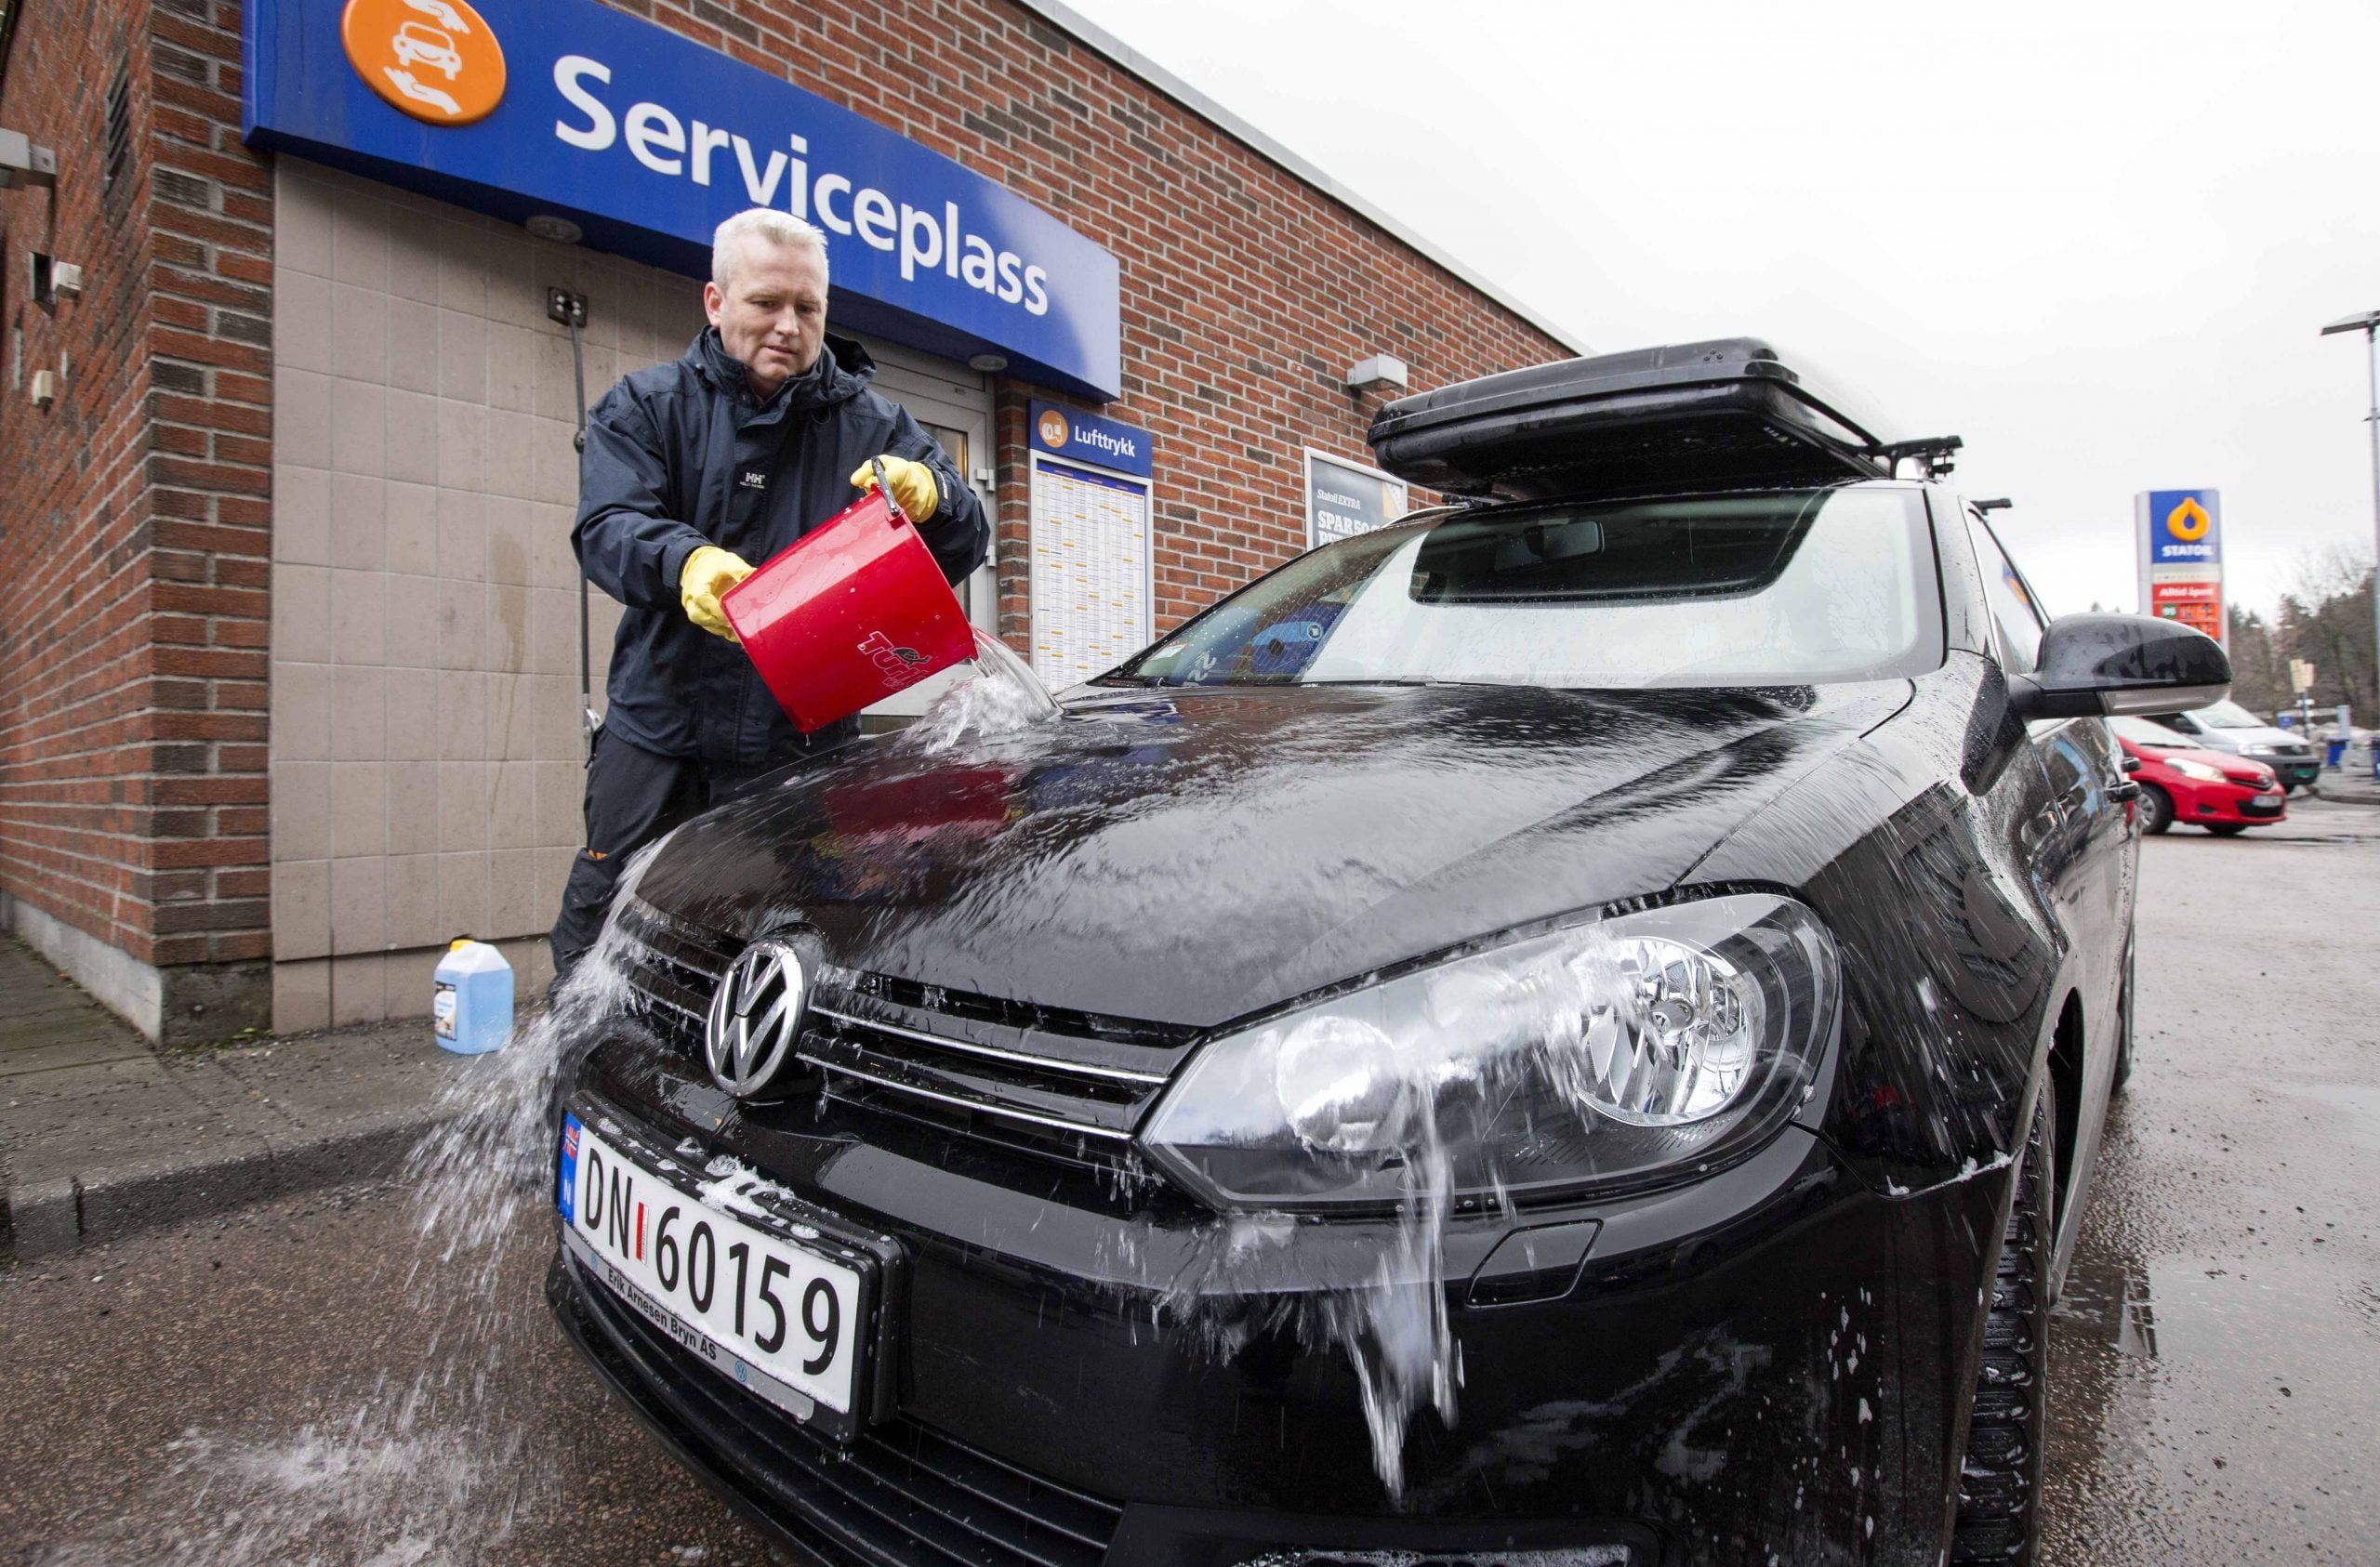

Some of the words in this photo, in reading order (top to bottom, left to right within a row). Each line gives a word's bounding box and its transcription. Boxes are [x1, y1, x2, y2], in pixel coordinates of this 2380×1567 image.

[553, 54, 1049, 317] Serviceplass
[1075, 425, 1136, 458] Lufttrykk
[1316, 488, 1338, 503] Statoil
[1338, 494, 1361, 510] EXTRA
[1317, 509, 1354, 536] SPAR
[563, 1179, 572, 1205] N
[655, 1206, 840, 1376] 60159
[608, 1268, 625, 1291] Erik
[628, 1288, 668, 1328] Arnesen
[670, 1317, 696, 1349] Bryn
[700, 1338, 717, 1361] AS
